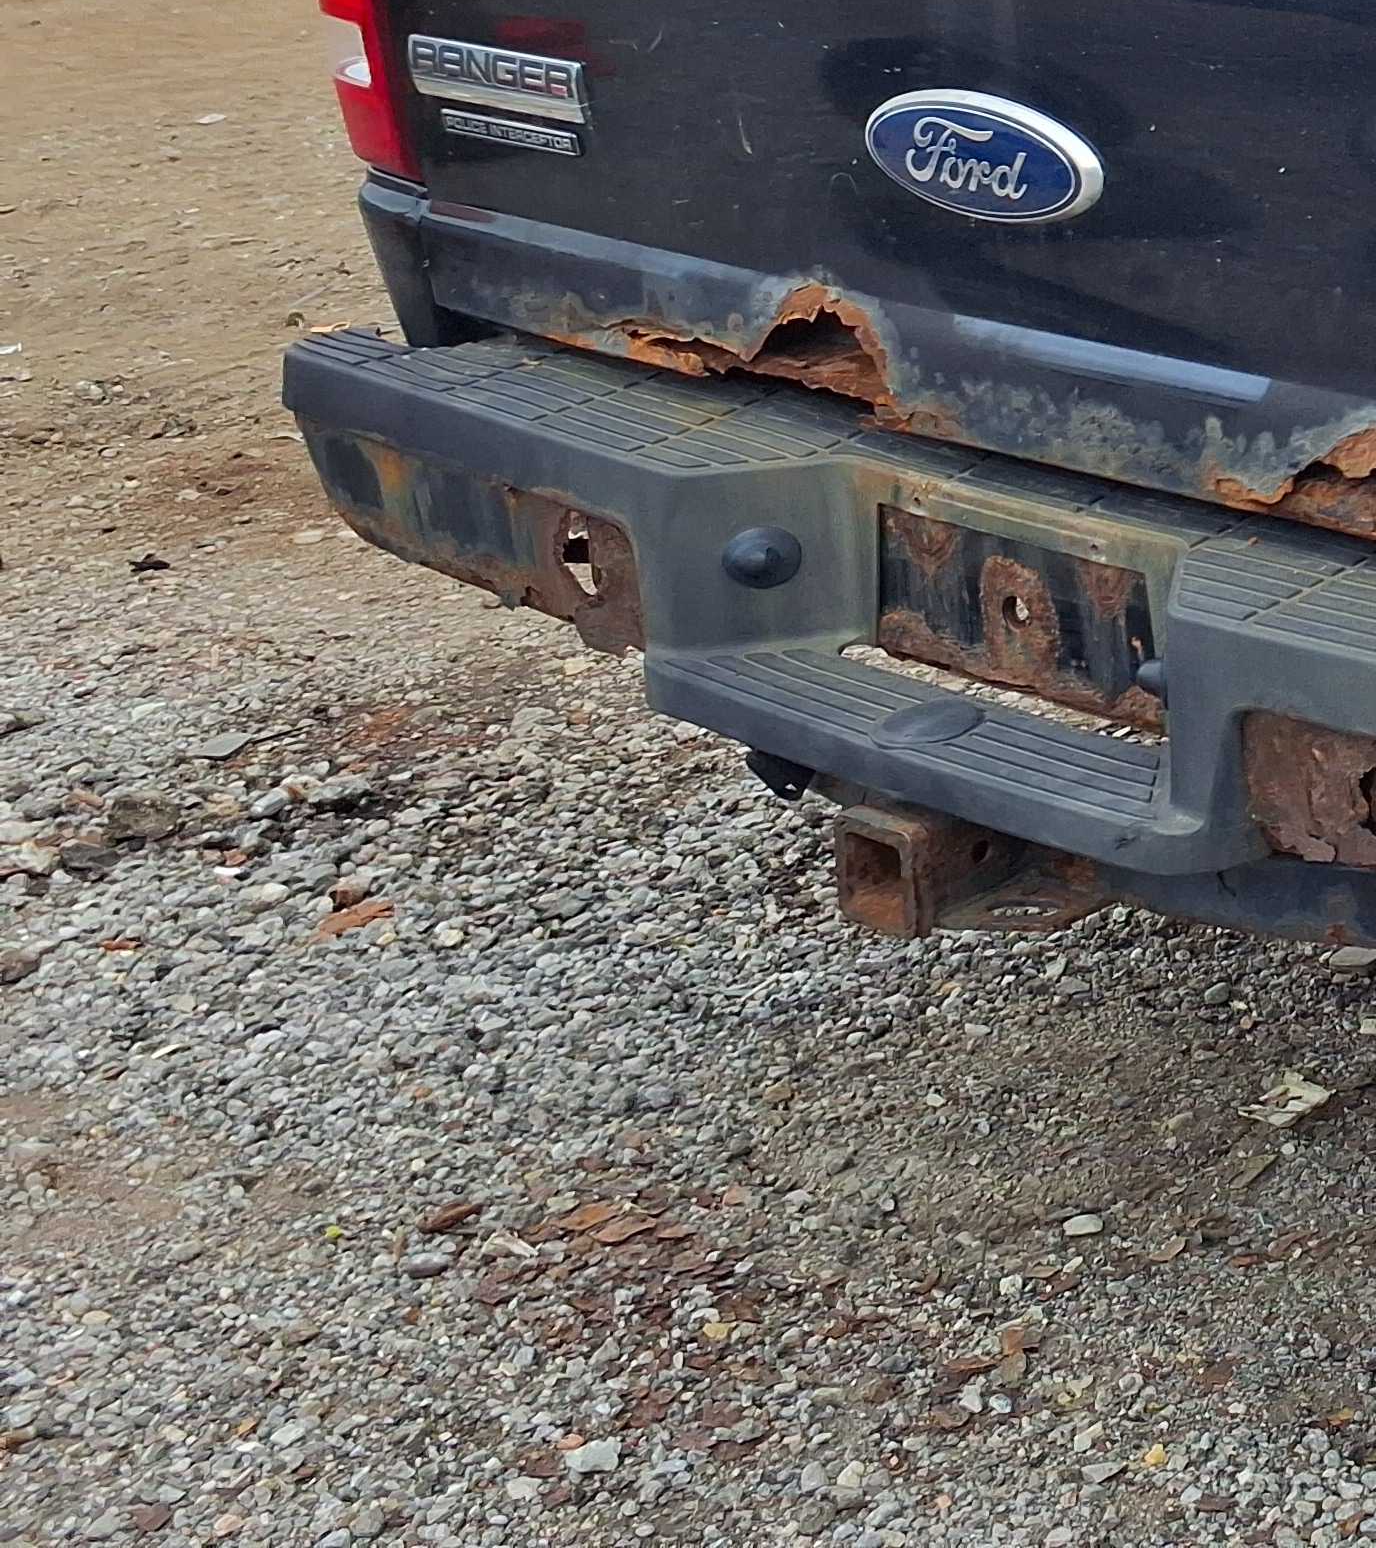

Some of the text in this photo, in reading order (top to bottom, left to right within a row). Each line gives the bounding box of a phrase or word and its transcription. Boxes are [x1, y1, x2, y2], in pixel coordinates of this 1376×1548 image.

[411, 39, 576, 100] RANGER
[446, 115, 574, 152] POLICE INTERCEPTOR
[904, 115, 1029, 201] Ford
